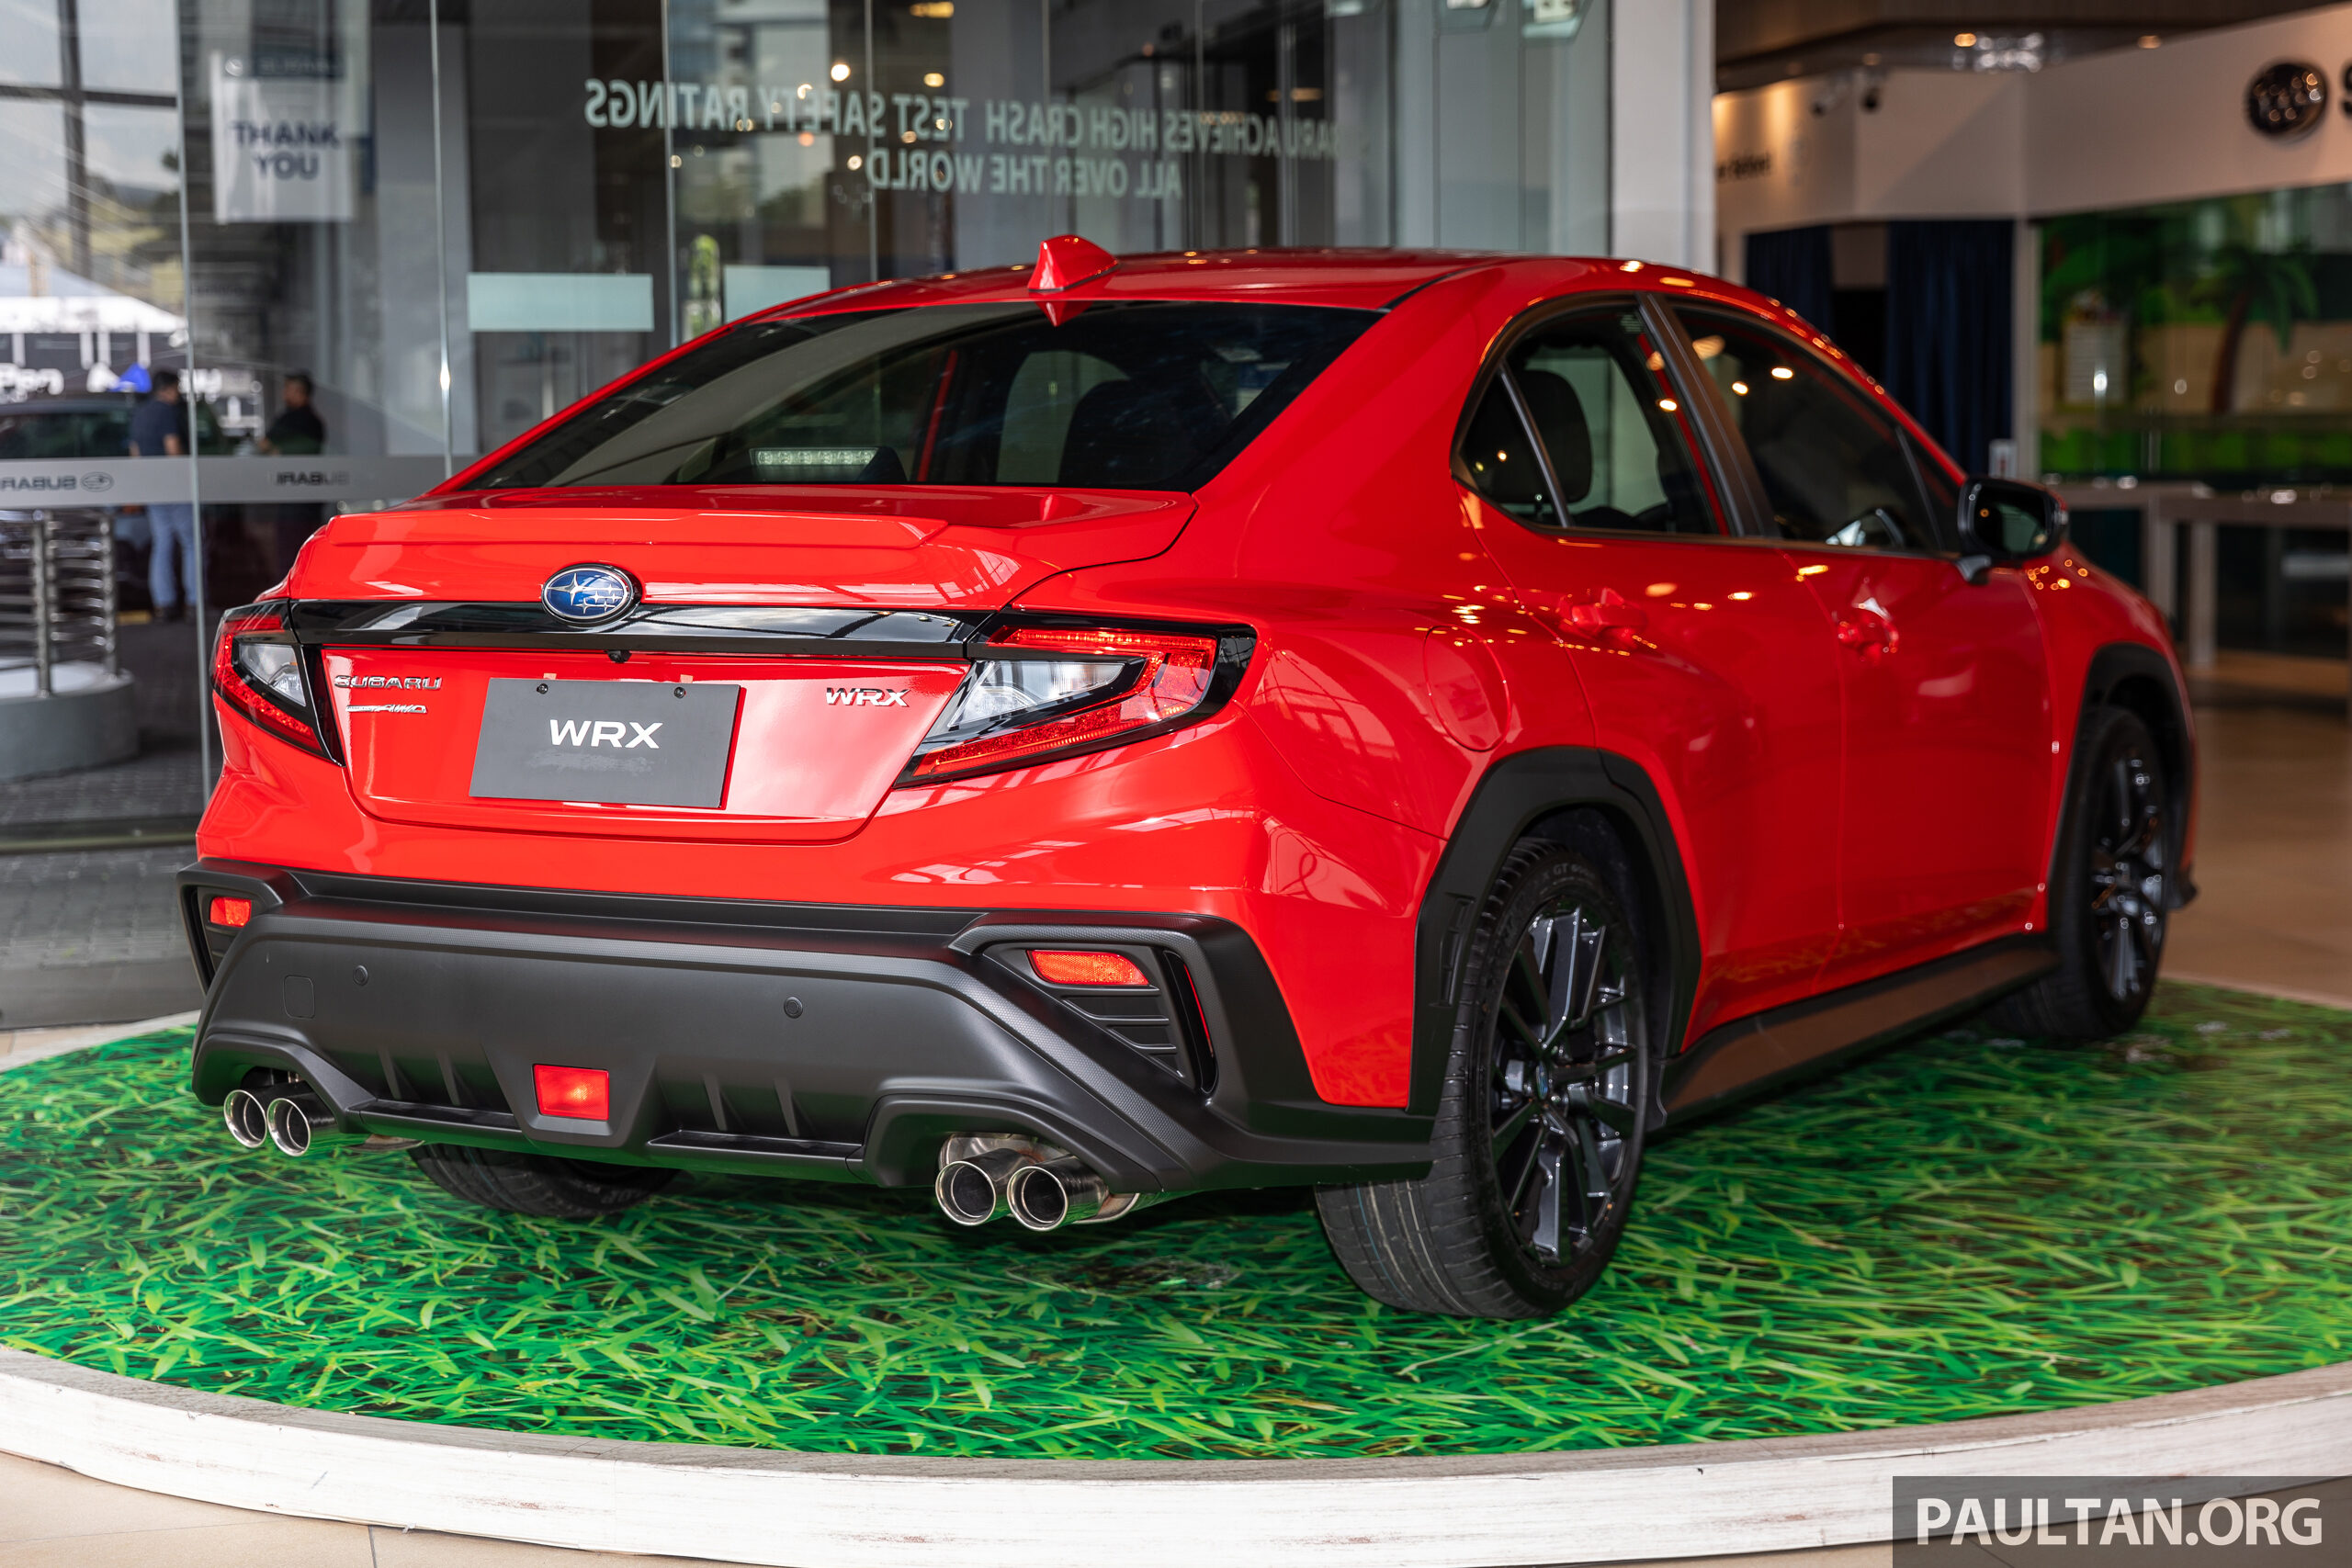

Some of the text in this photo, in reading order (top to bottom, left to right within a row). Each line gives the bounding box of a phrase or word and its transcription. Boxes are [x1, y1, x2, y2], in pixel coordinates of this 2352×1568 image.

[231, 120, 340, 148] THANK
[254, 152, 319, 179] YOU
[334, 675, 442, 689] SUBARU
[826, 687, 911, 707] WRX
[550, 719, 663, 749] WRX
